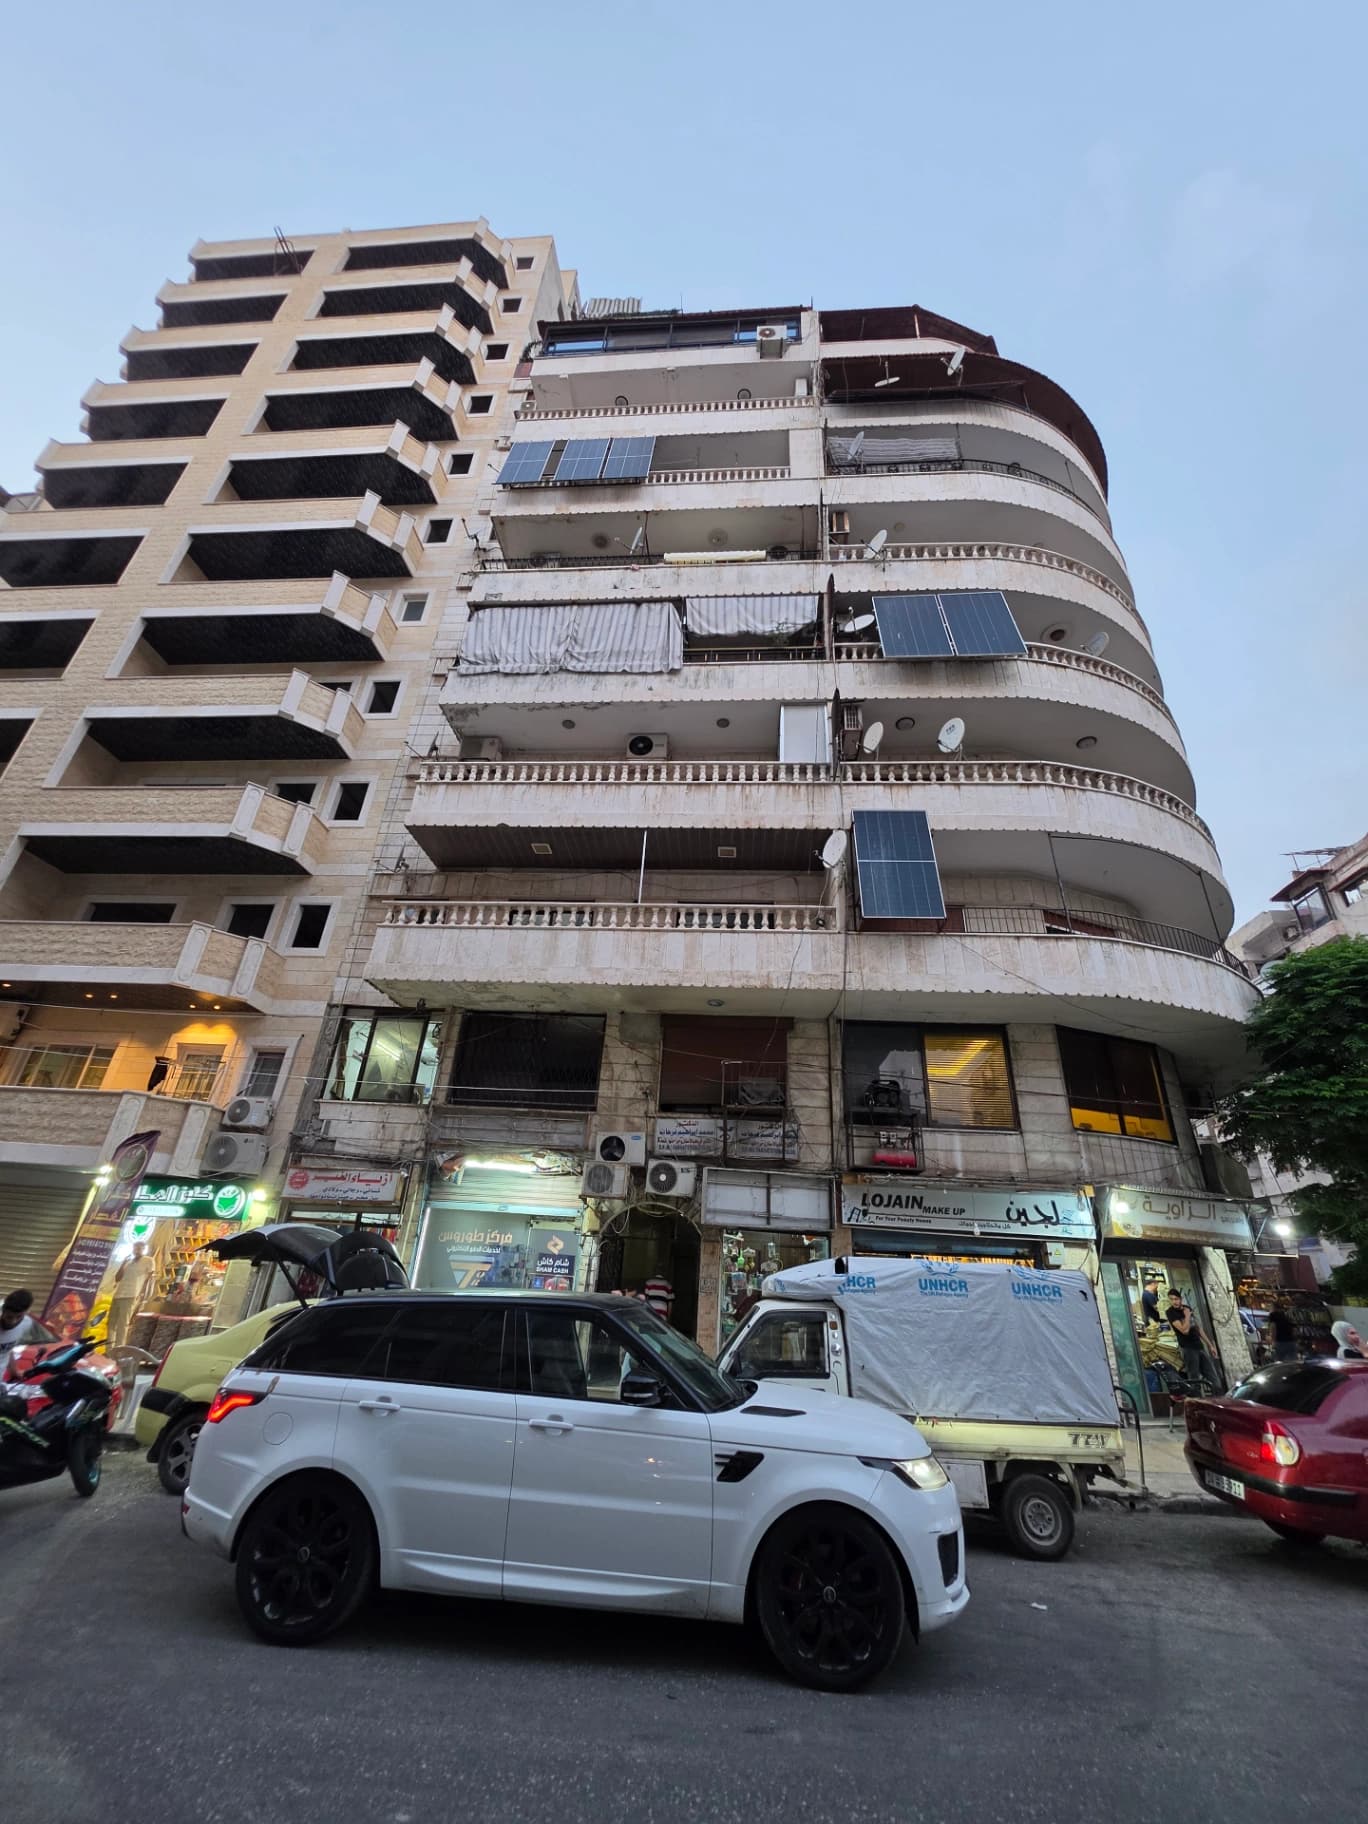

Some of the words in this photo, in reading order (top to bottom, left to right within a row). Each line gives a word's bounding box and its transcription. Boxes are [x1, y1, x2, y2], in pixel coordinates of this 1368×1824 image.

[861, 1193, 924, 1209] LOJAIN
[1143, 1195, 1217, 1221] الزاوية
[922, 1206, 951, 1215] MAKE
[952, 1207, 966, 1216] UP
[537, 1257, 554, 1266] كاش
[554, 1257, 570, 1267] شام
[919, 1278, 969, 1293] UNHCR
[1011, 1282, 1063, 1298] UNHCR
